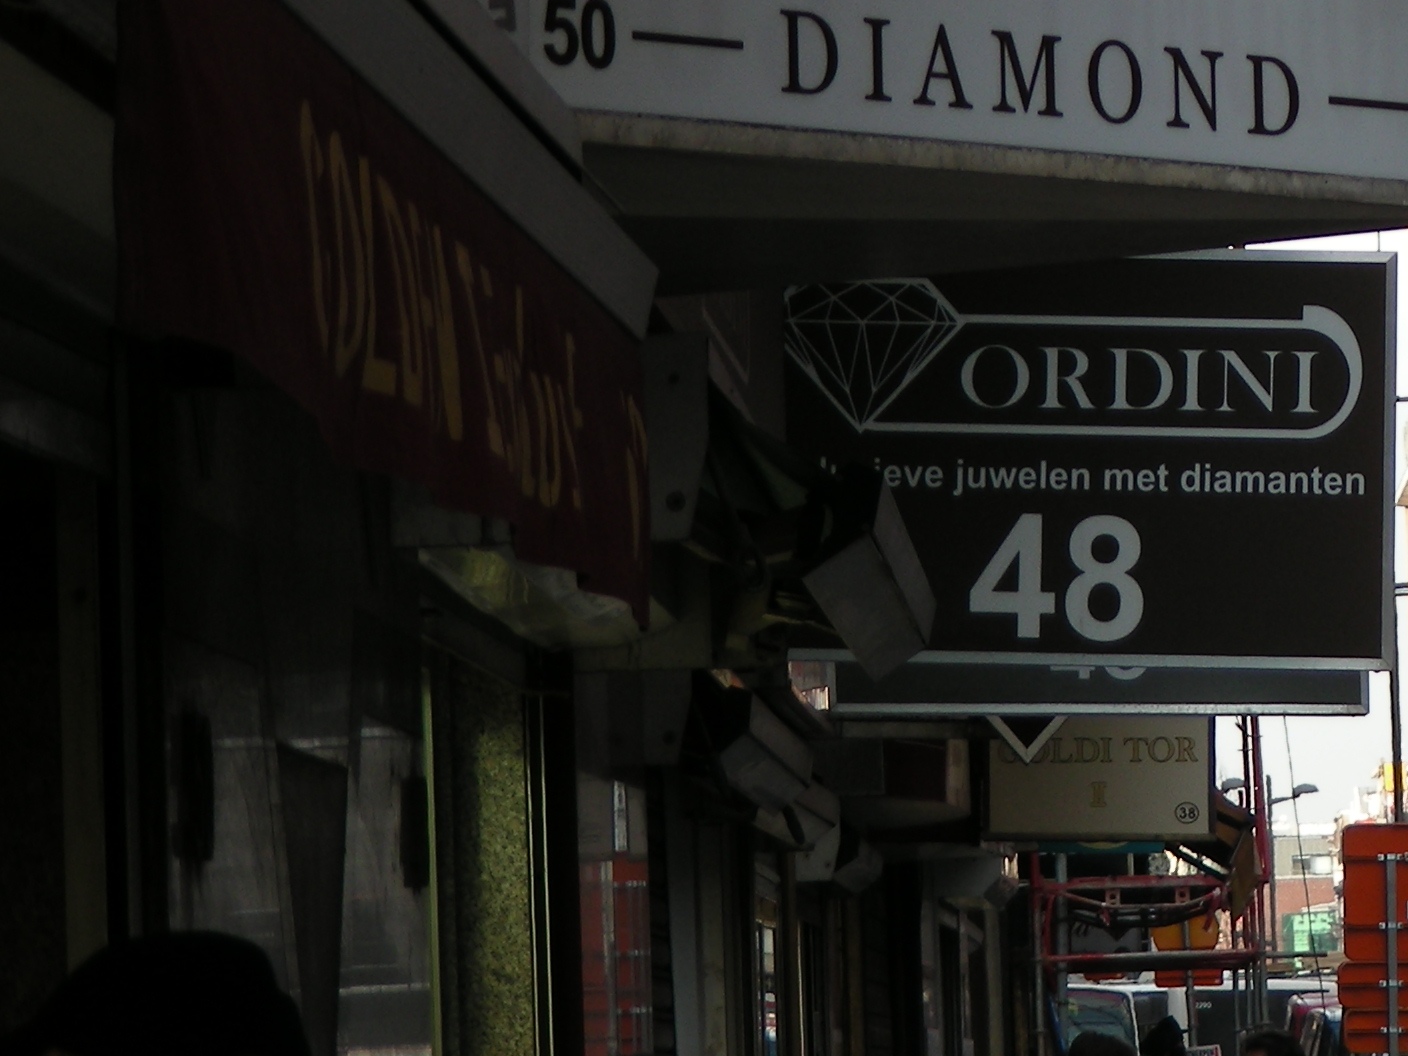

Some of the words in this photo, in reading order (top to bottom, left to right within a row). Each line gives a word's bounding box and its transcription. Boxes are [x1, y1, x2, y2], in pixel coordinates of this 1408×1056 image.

[779, 8, 1302, 137] DIAMOND
[960, 343, 1321, 414] ORDINI
[952, 459, 1092, 498] juwelen
[1103, 465, 1169, 493] met
[1180, 462, 1366, 496] diamanten
[968, 511, 1146, 642] 48
[1123, 736, 1199, 763] TOR
[1178, 807, 1197, 820] 38
